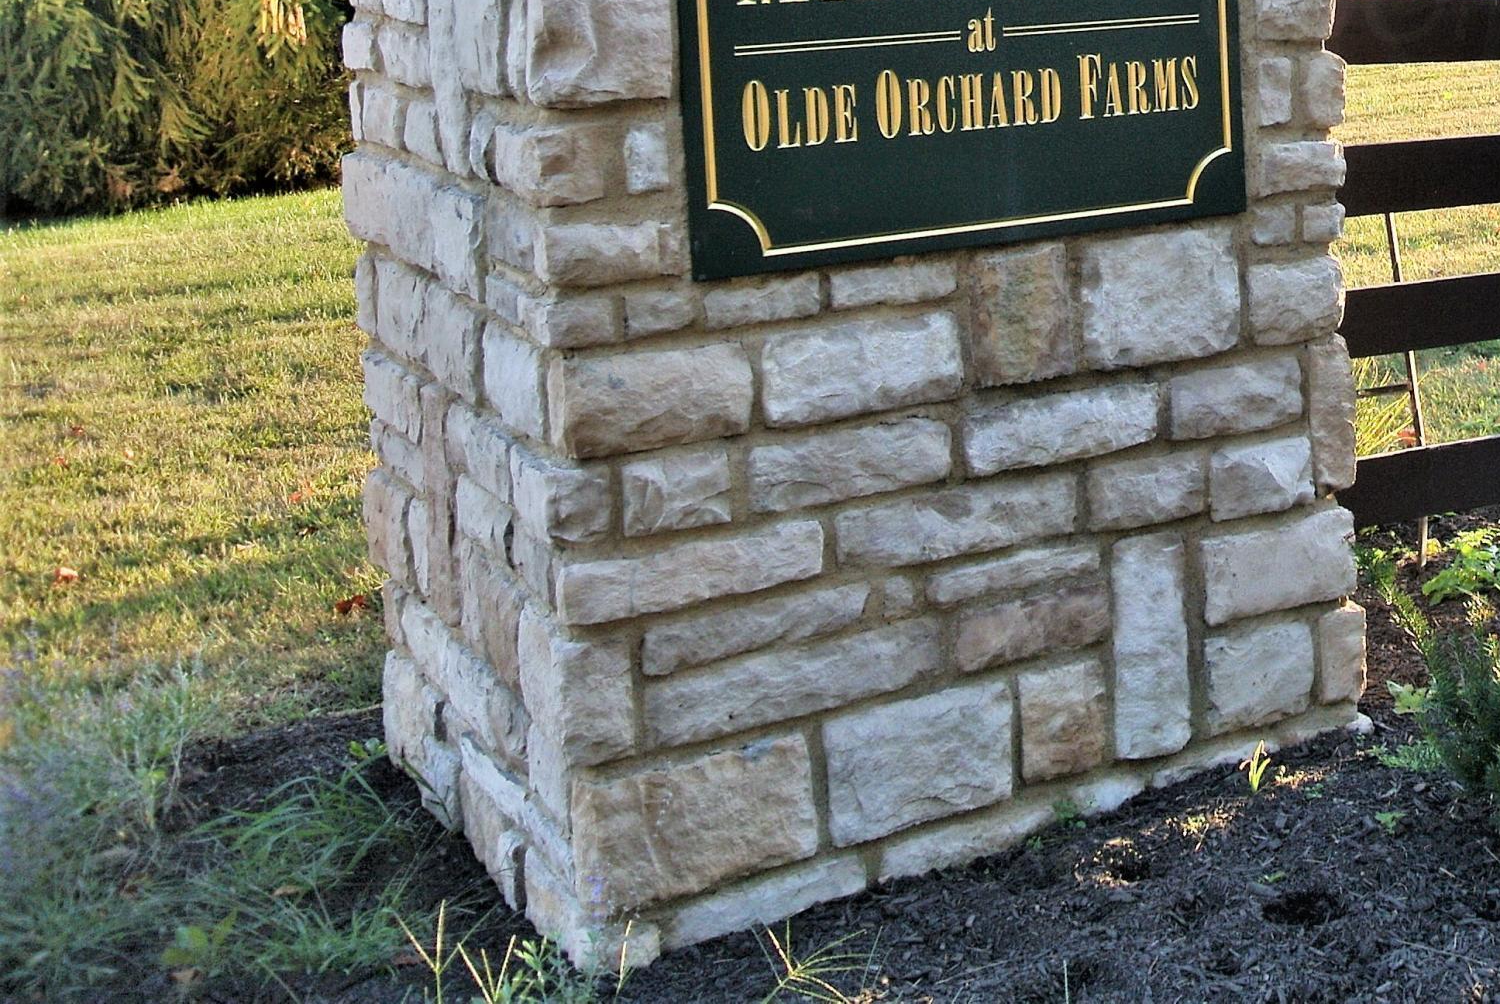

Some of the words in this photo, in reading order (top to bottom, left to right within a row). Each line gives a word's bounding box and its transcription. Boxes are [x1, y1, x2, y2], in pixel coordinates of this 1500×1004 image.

[966, 6, 997, 53] at
[741, 79, 858, 152] OLDE
[875, 67, 1062, 140] ORCHARD
[1076, 52, 1199, 120] FARMS
